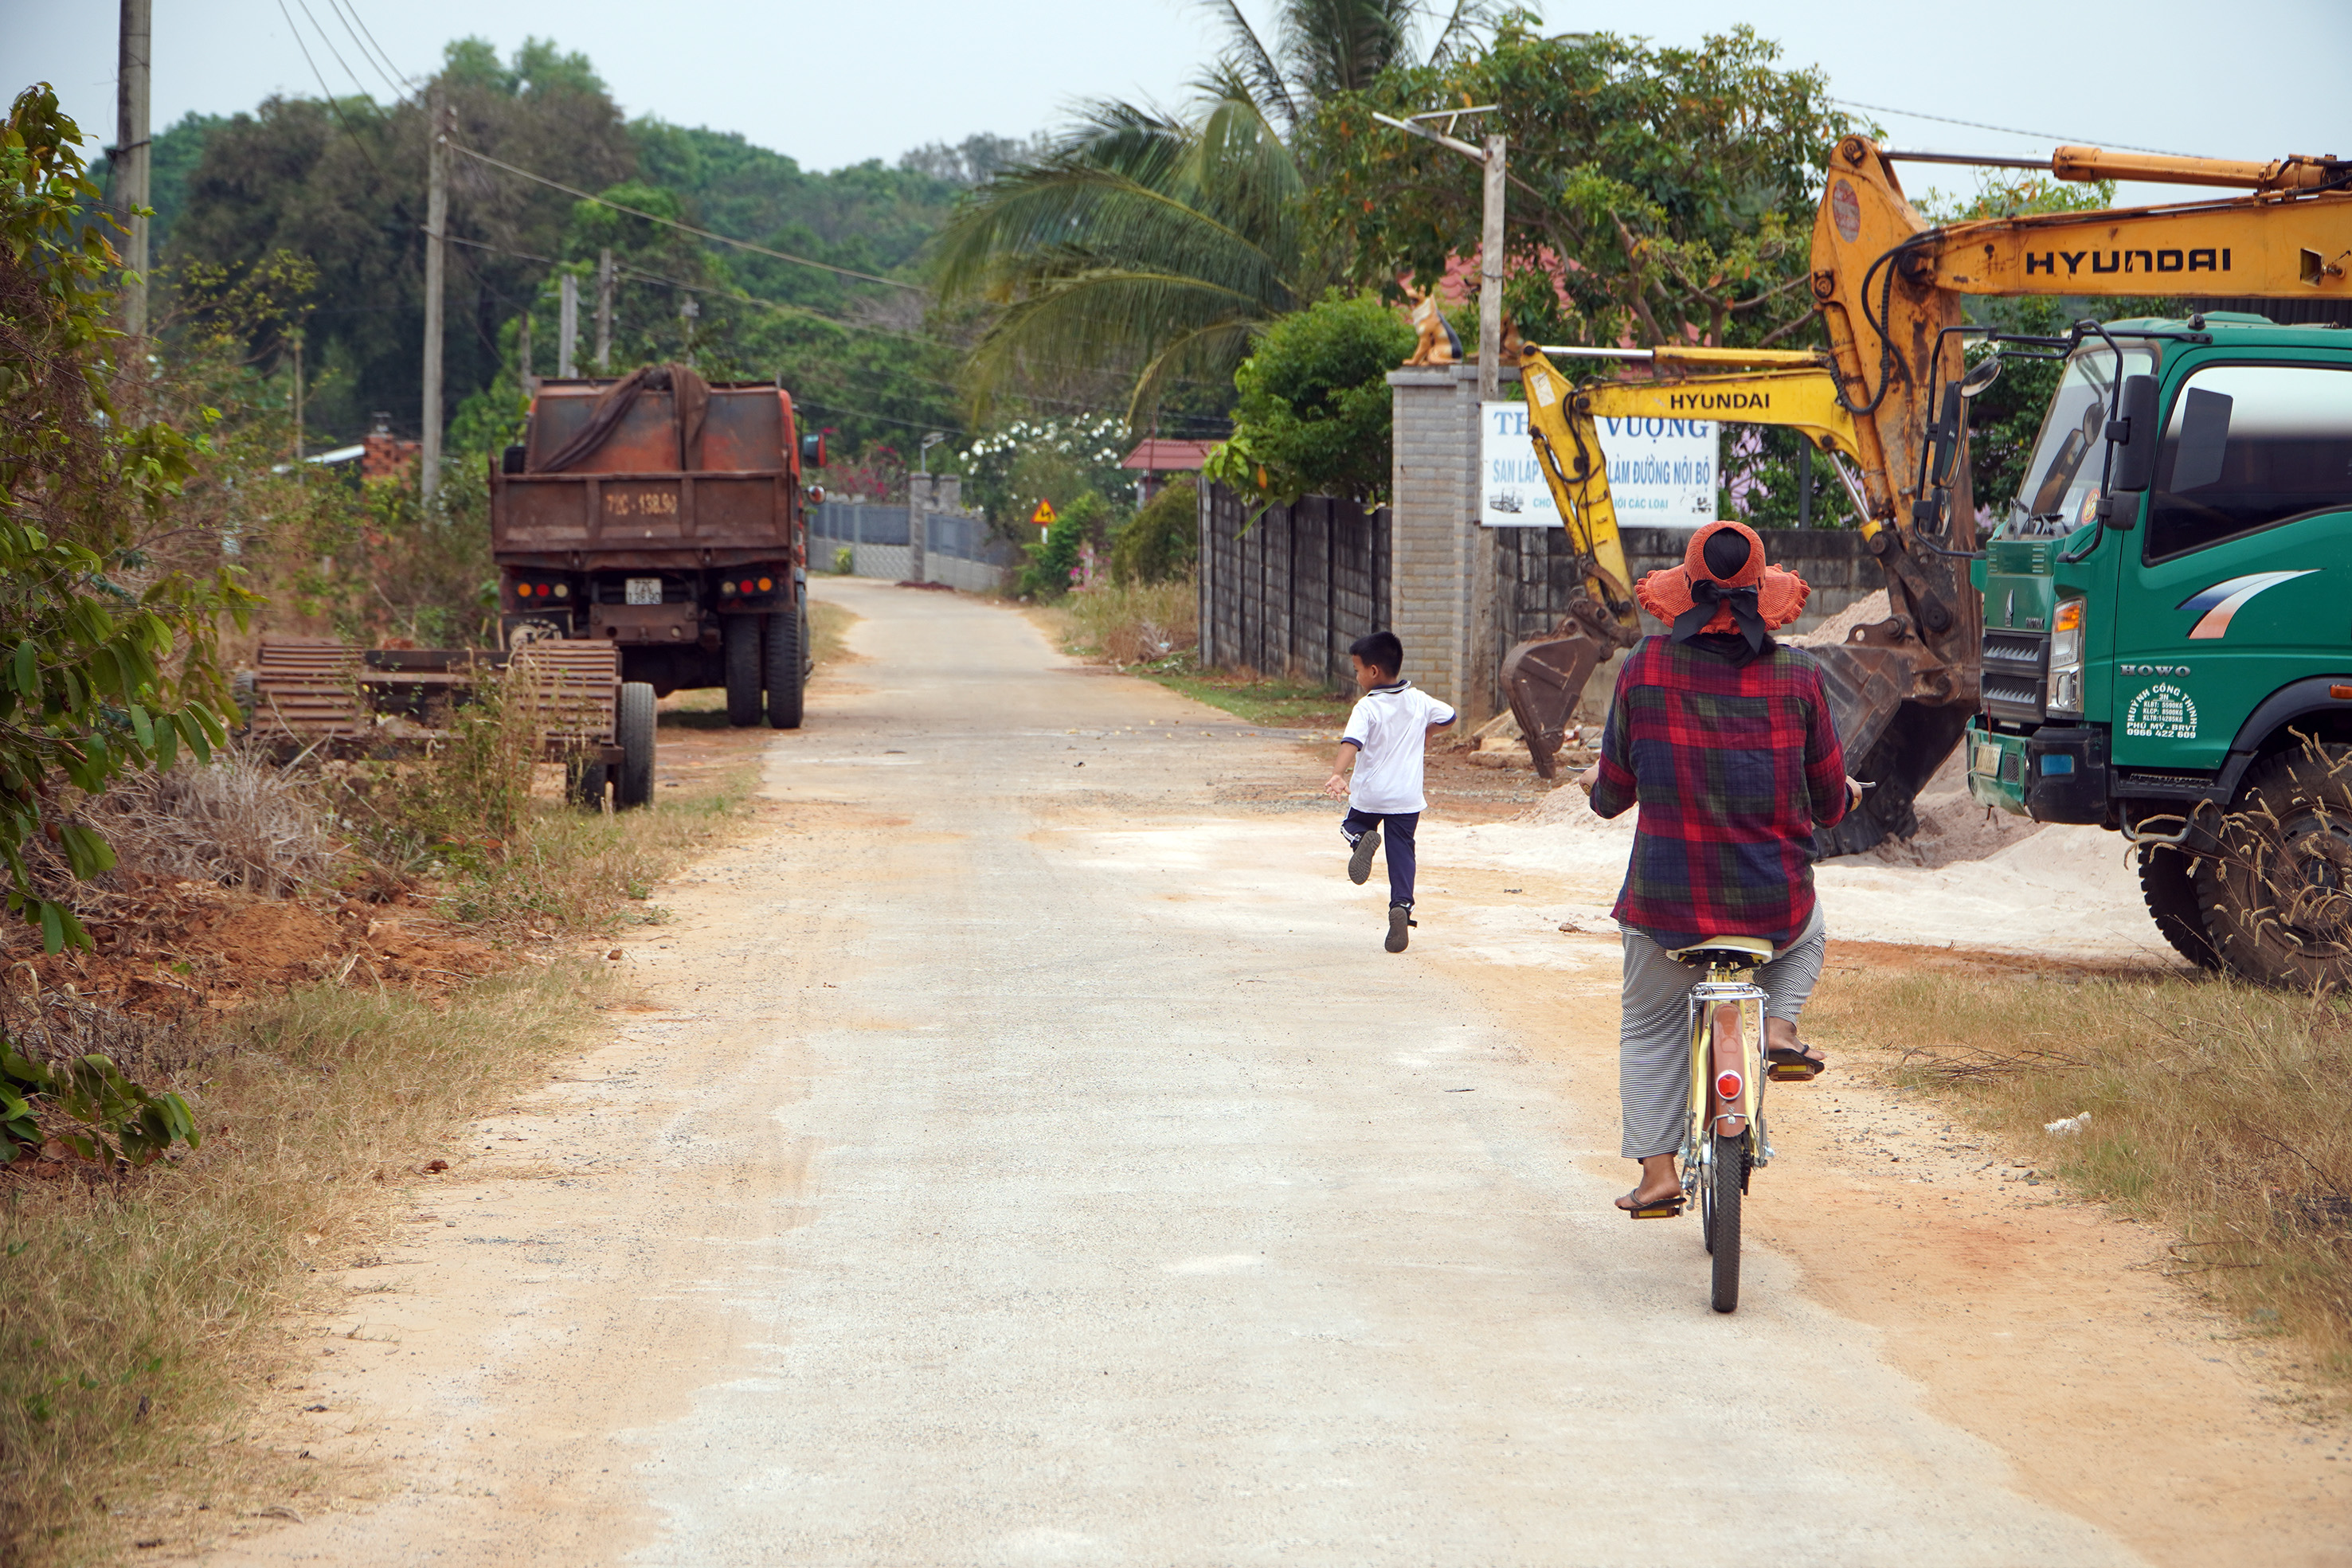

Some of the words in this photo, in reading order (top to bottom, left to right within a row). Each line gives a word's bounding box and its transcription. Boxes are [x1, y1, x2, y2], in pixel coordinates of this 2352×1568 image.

[2026, 248, 2230, 275] HYUNDAI
[1670, 393, 1770, 409] HYUNDAI
[1493, 459, 1515, 483] SAN
[1518, 449, 1539, 483] LẤP
[1608, 453, 1630, 484] LÀM
[1633, 453, 1670, 484] ĐƯỜNG
[1673, 455, 1692, 492] NỘI
[1696, 455, 1710, 492] BỘ
[1533, 498, 1552, 508] CHO
[2120, 664, 2191, 678] HOWO
[2127, 689, 2150, 721] HUỲNH
[2152, 682, 2181, 696] CÔNG
[2182, 693, 2197, 725] THỊNH
[2150, 721, 2165, 730] MỸ
